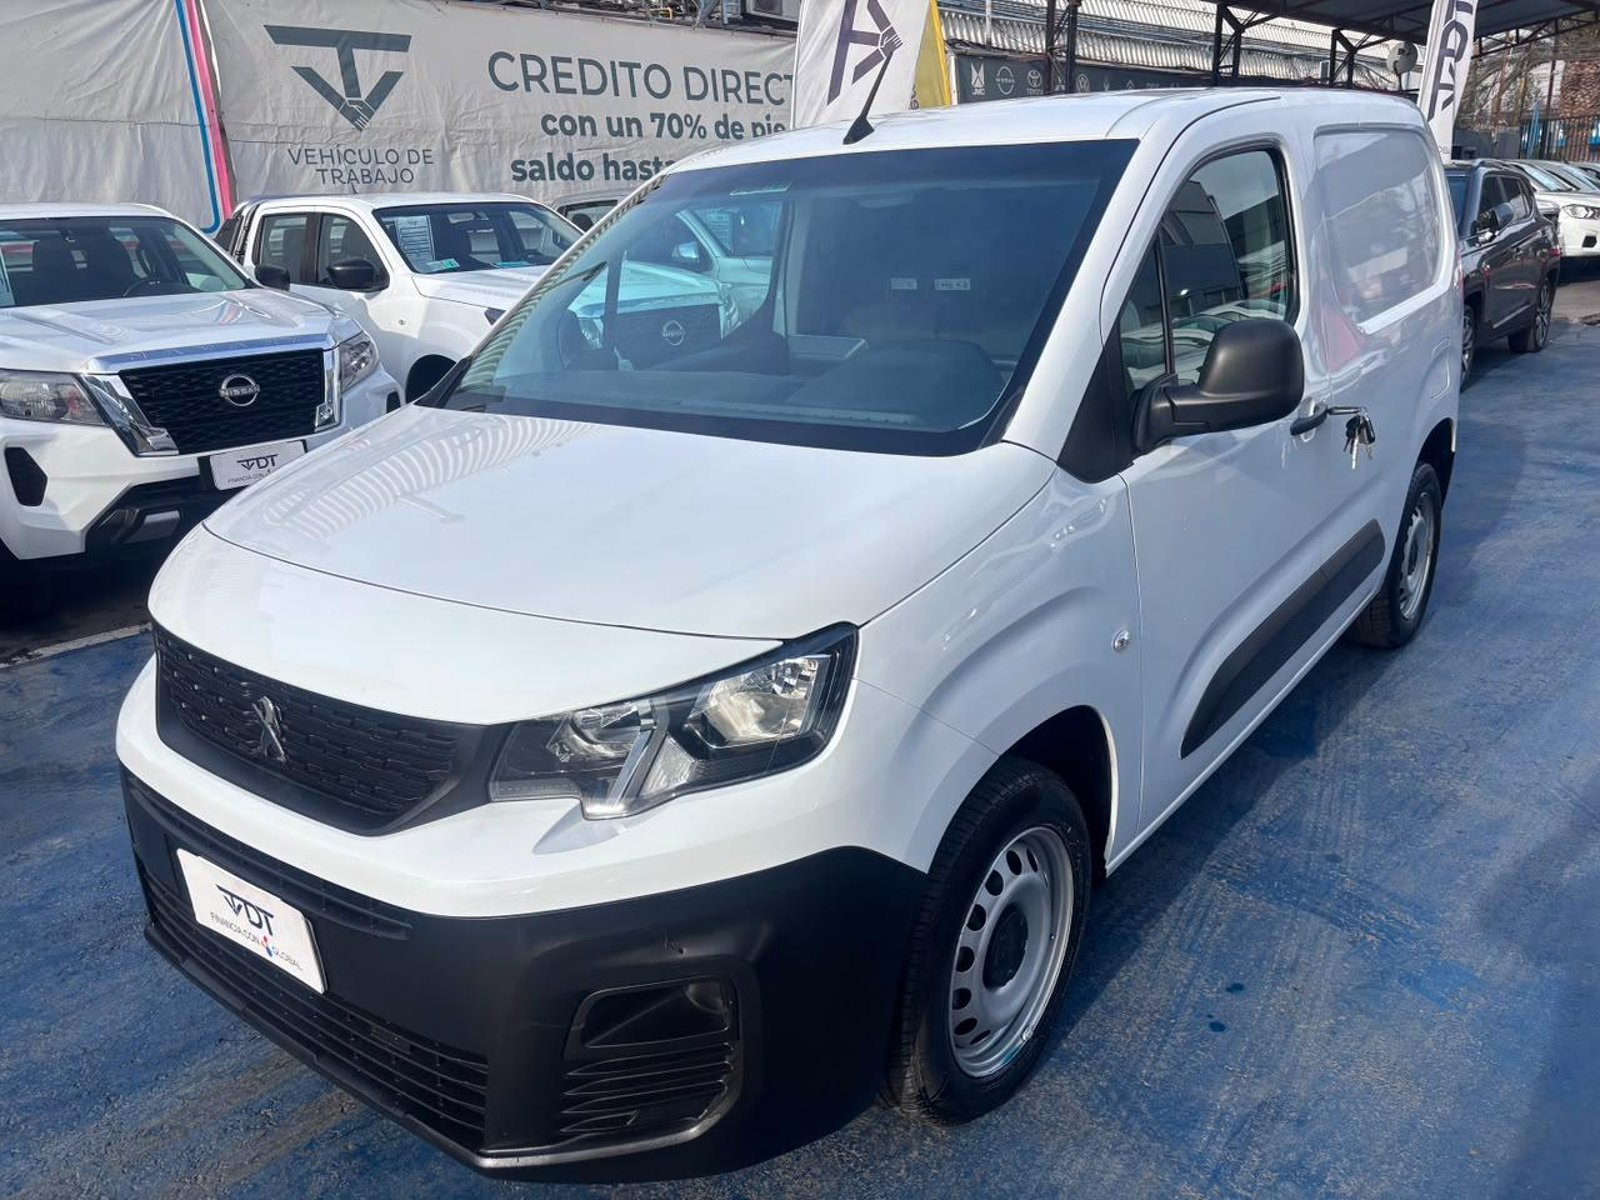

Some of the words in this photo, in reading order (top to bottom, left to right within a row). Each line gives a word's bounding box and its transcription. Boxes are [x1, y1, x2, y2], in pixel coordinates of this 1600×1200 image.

[488, 51, 671, 100] CREDITO
[541, 113, 597, 137] con
[607, 115, 643, 138] un
[650, 112, 707, 139] 70%
[714, 113, 744, 140] de
[408, 149, 434, 165] DE
[511, 152, 594, 182] saldo
[603, 152, 676, 181] hast
[317, 168, 414, 184] TRABAJO
[219, 383, 260, 398] NISSAN
